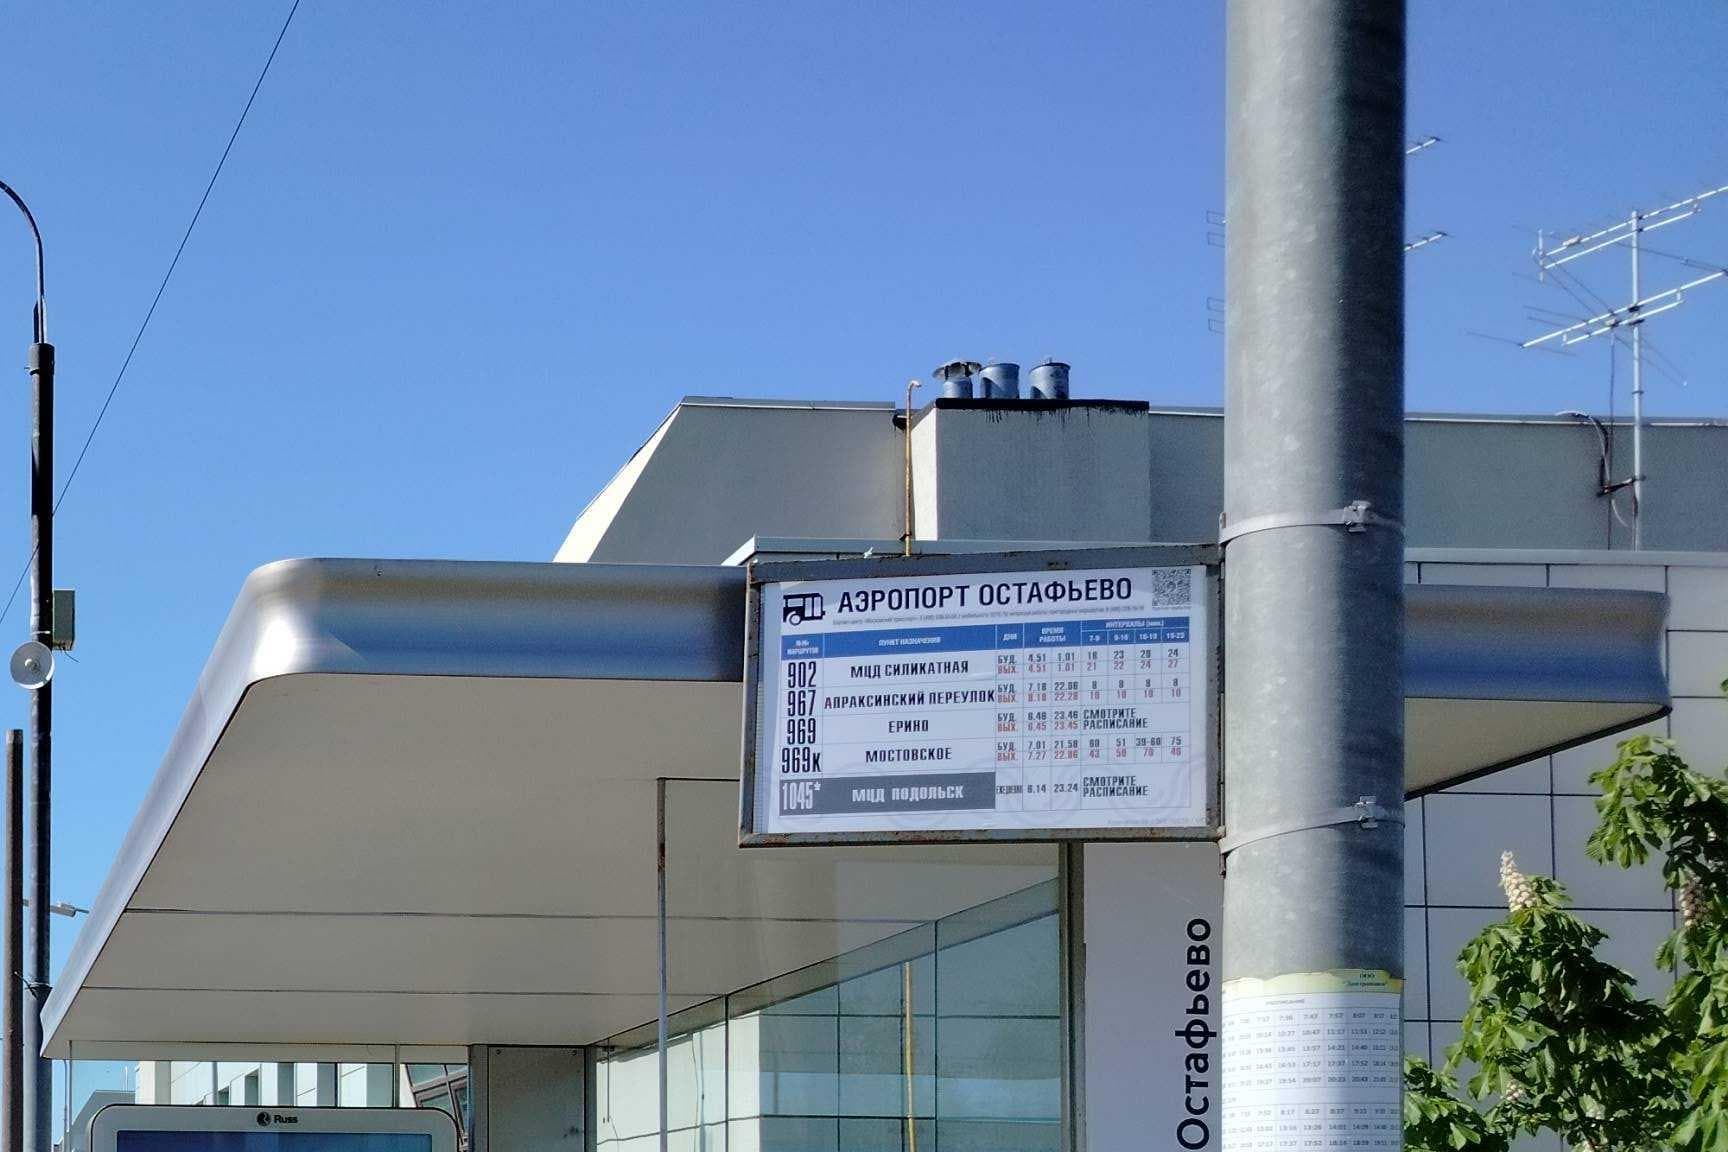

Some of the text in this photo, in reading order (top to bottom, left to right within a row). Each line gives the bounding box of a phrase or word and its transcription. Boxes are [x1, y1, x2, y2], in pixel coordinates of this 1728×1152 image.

[837, 577, 1132, 614] АЭРОПОРТ ОСТАФЬЕВО
[1168, 649, 1179, 658] 24
[788, 661, 817, 688] 902
[851, 661, 969, 679] МЦД СИЛИКАТНАЯ
[787, 690, 817, 717] 967
[824, 689, 996, 709] АПРАКСИНСКИЙ ПЕРЕУЛОК
[1083, 708, 1136, 719] СМОТРИТЕ
[787, 718, 816, 745] 969
[888, 720, 929, 733] ЕРИНО
[1083, 718, 1148, 730] РАСПИСАНИЕ
[1171, 737, 1181, 745] 75
[865, 748, 952, 763] МОСТОВСКОЕ
[1083, 776, 1136, 787] СМОТРИТЕ
[852, 785, 964, 802] МЦД ПОДОЛЬСК
[1083, 785, 1148, 797] РАСПИСАНИЕ
[1174, 917, 1217, 1150] Остафьево
[273, 1114, 298, 1124] Russ
